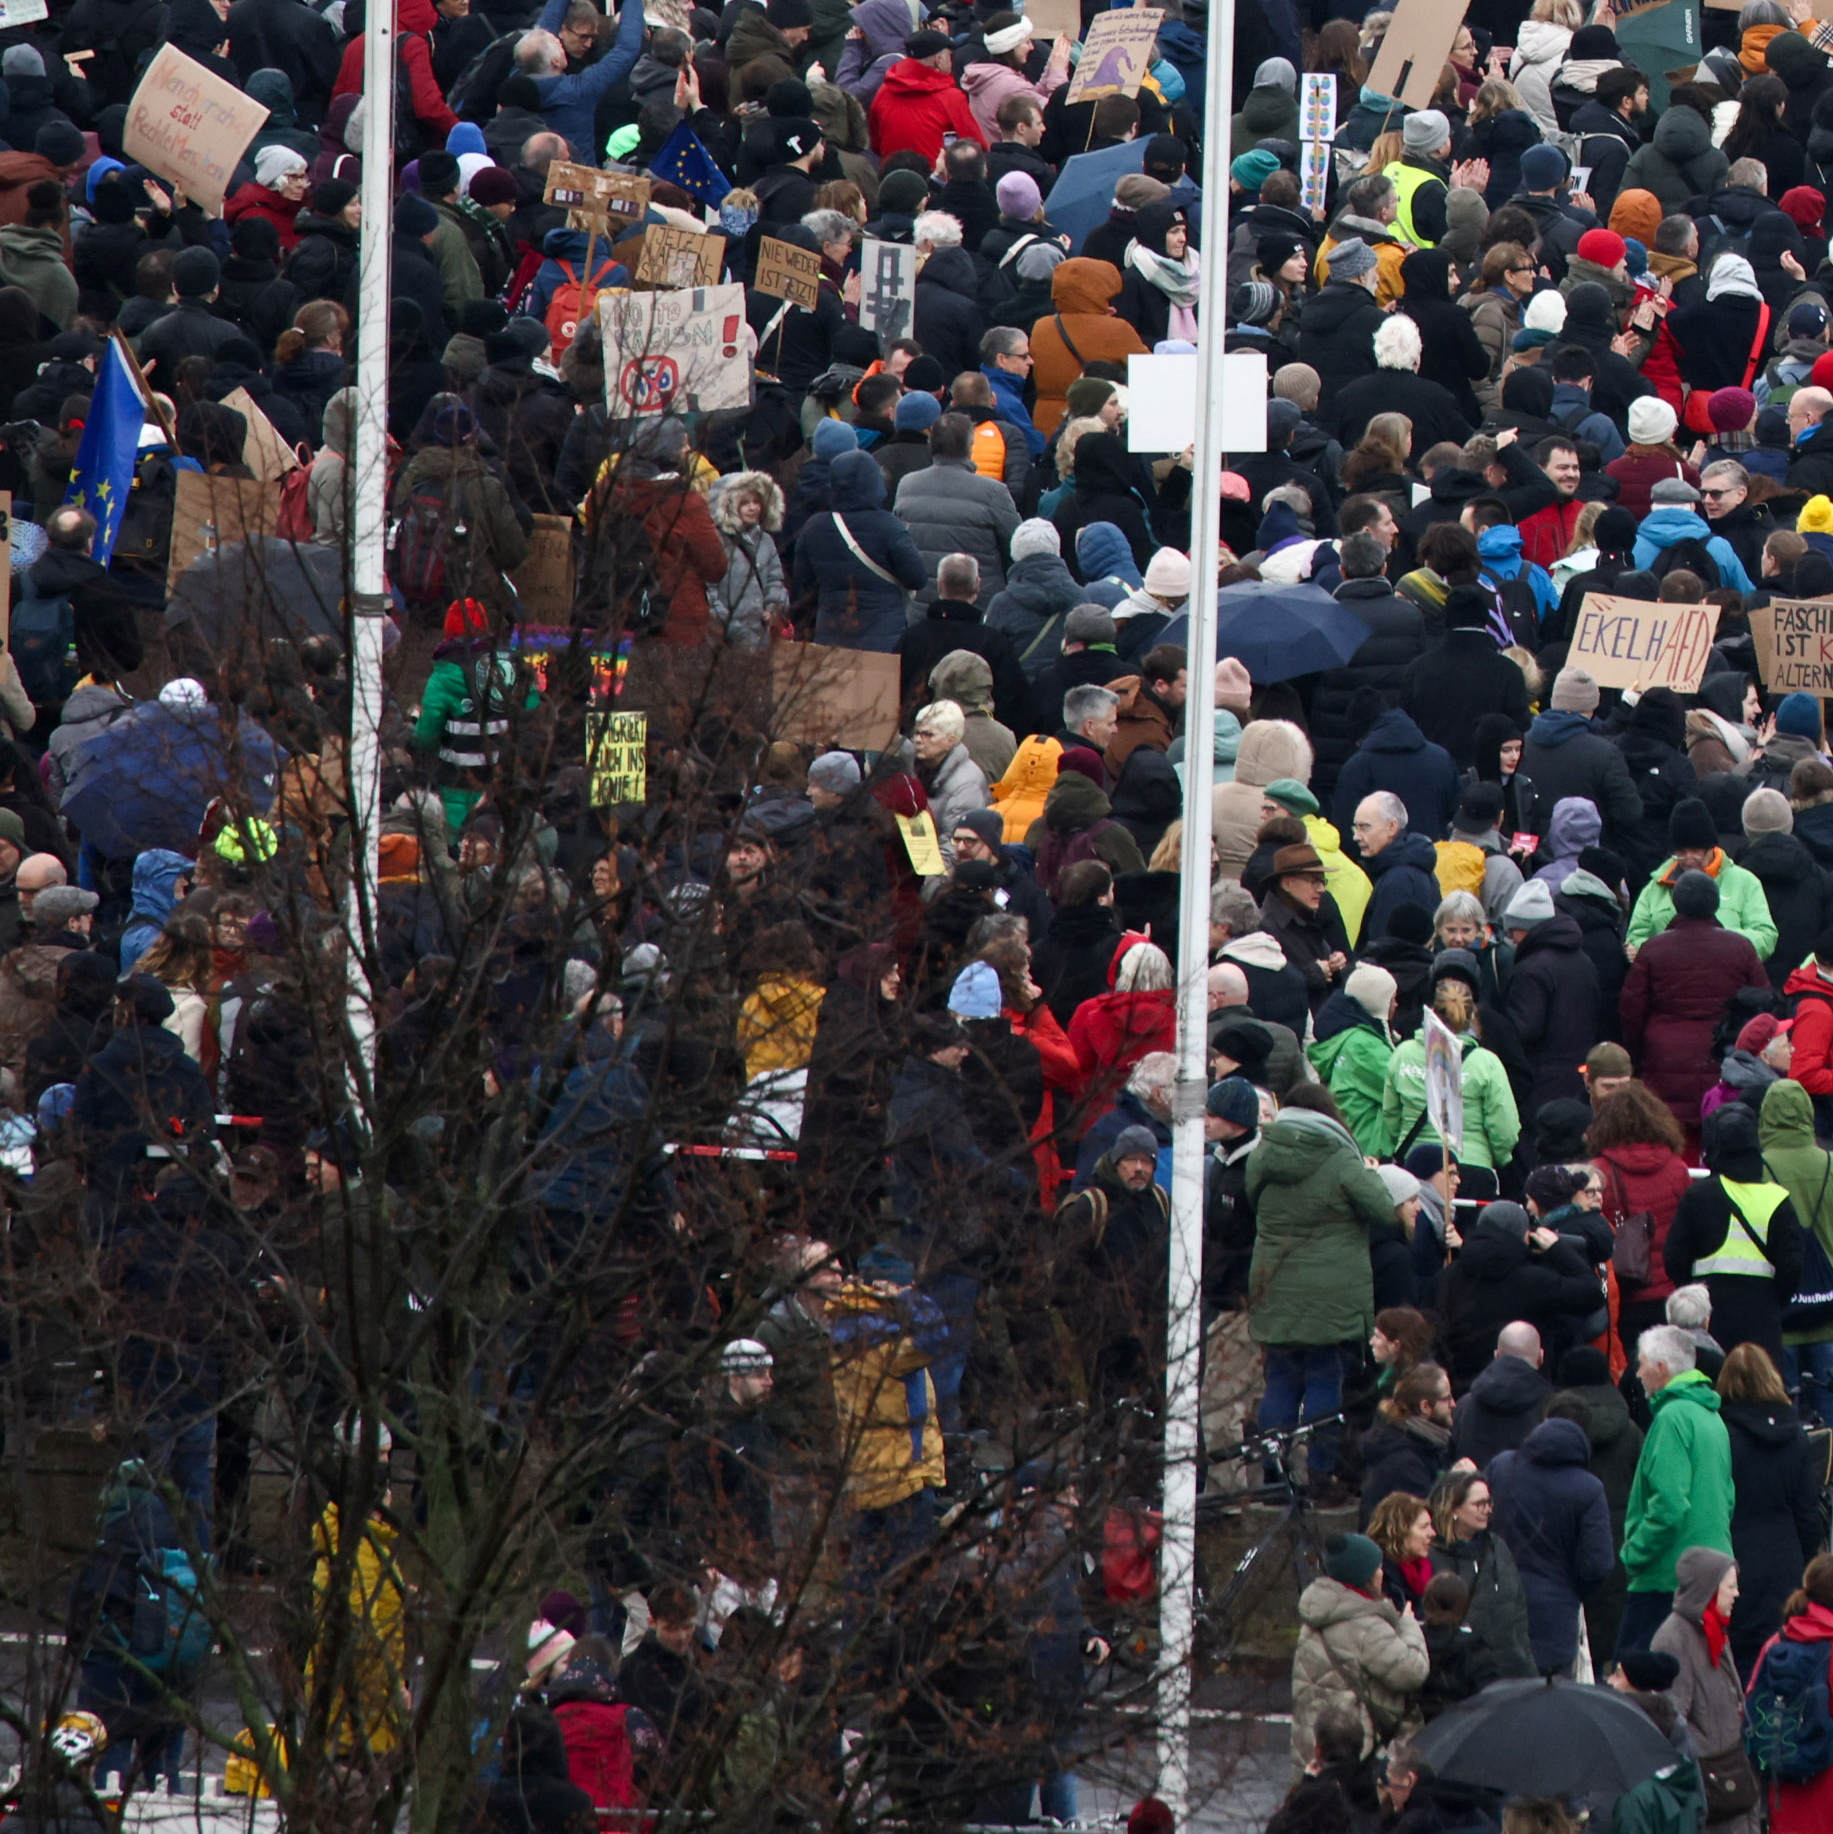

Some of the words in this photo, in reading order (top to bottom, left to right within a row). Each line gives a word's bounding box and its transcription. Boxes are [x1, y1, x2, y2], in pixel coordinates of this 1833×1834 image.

[170, 103, 203, 131] statt
[761, 241, 783, 264] NIE
[785, 249, 821, 277] WIEDER
[760, 267, 784, 288] IST
[1578, 609, 1711, 683] EKELHAFD
[1776, 634, 1812, 657] IST
